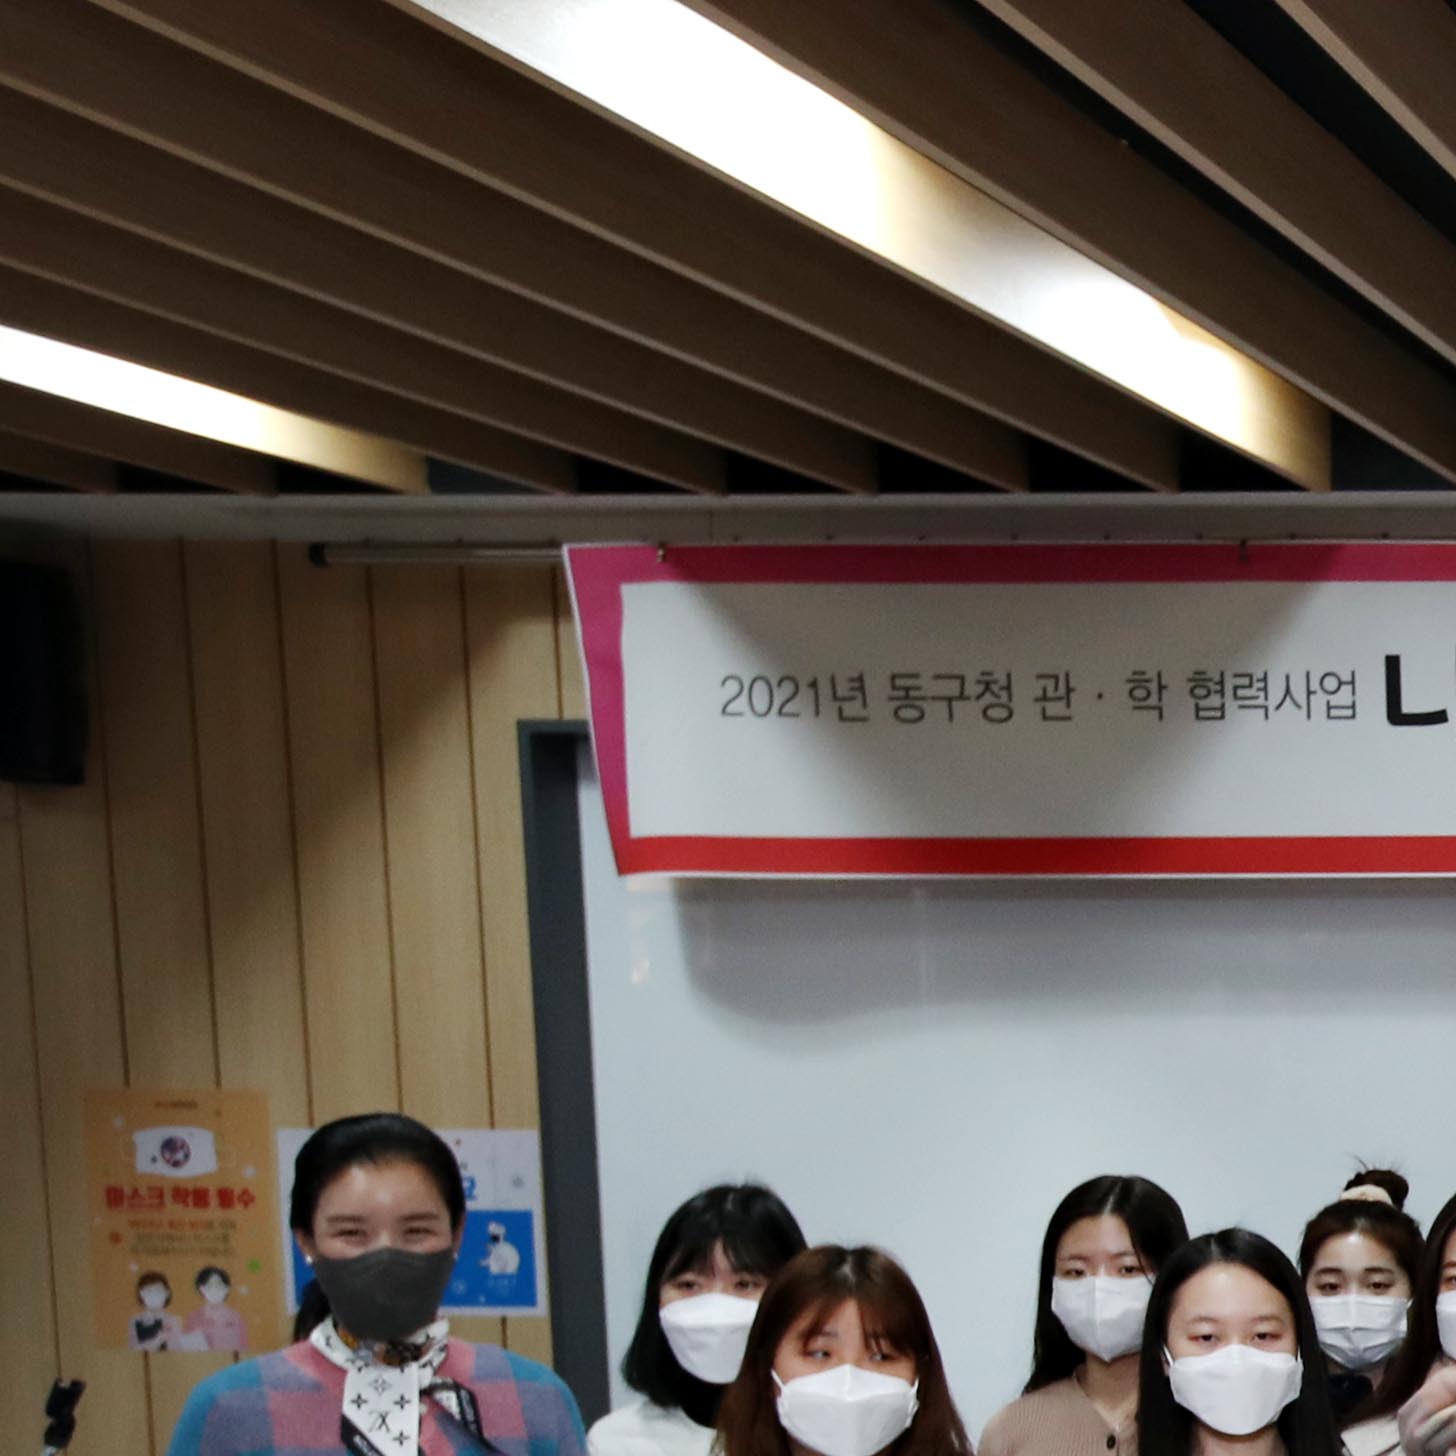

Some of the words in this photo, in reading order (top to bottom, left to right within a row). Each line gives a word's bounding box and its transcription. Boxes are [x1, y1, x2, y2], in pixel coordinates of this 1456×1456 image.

[720, 671, 870, 723] 2021년
[888, 671, 1014, 724] 동구청
[1033, 671, 1076, 722] 관
[1125, 670, 1168, 722] 학
[1187, 670, 1356, 721] 협력사업
